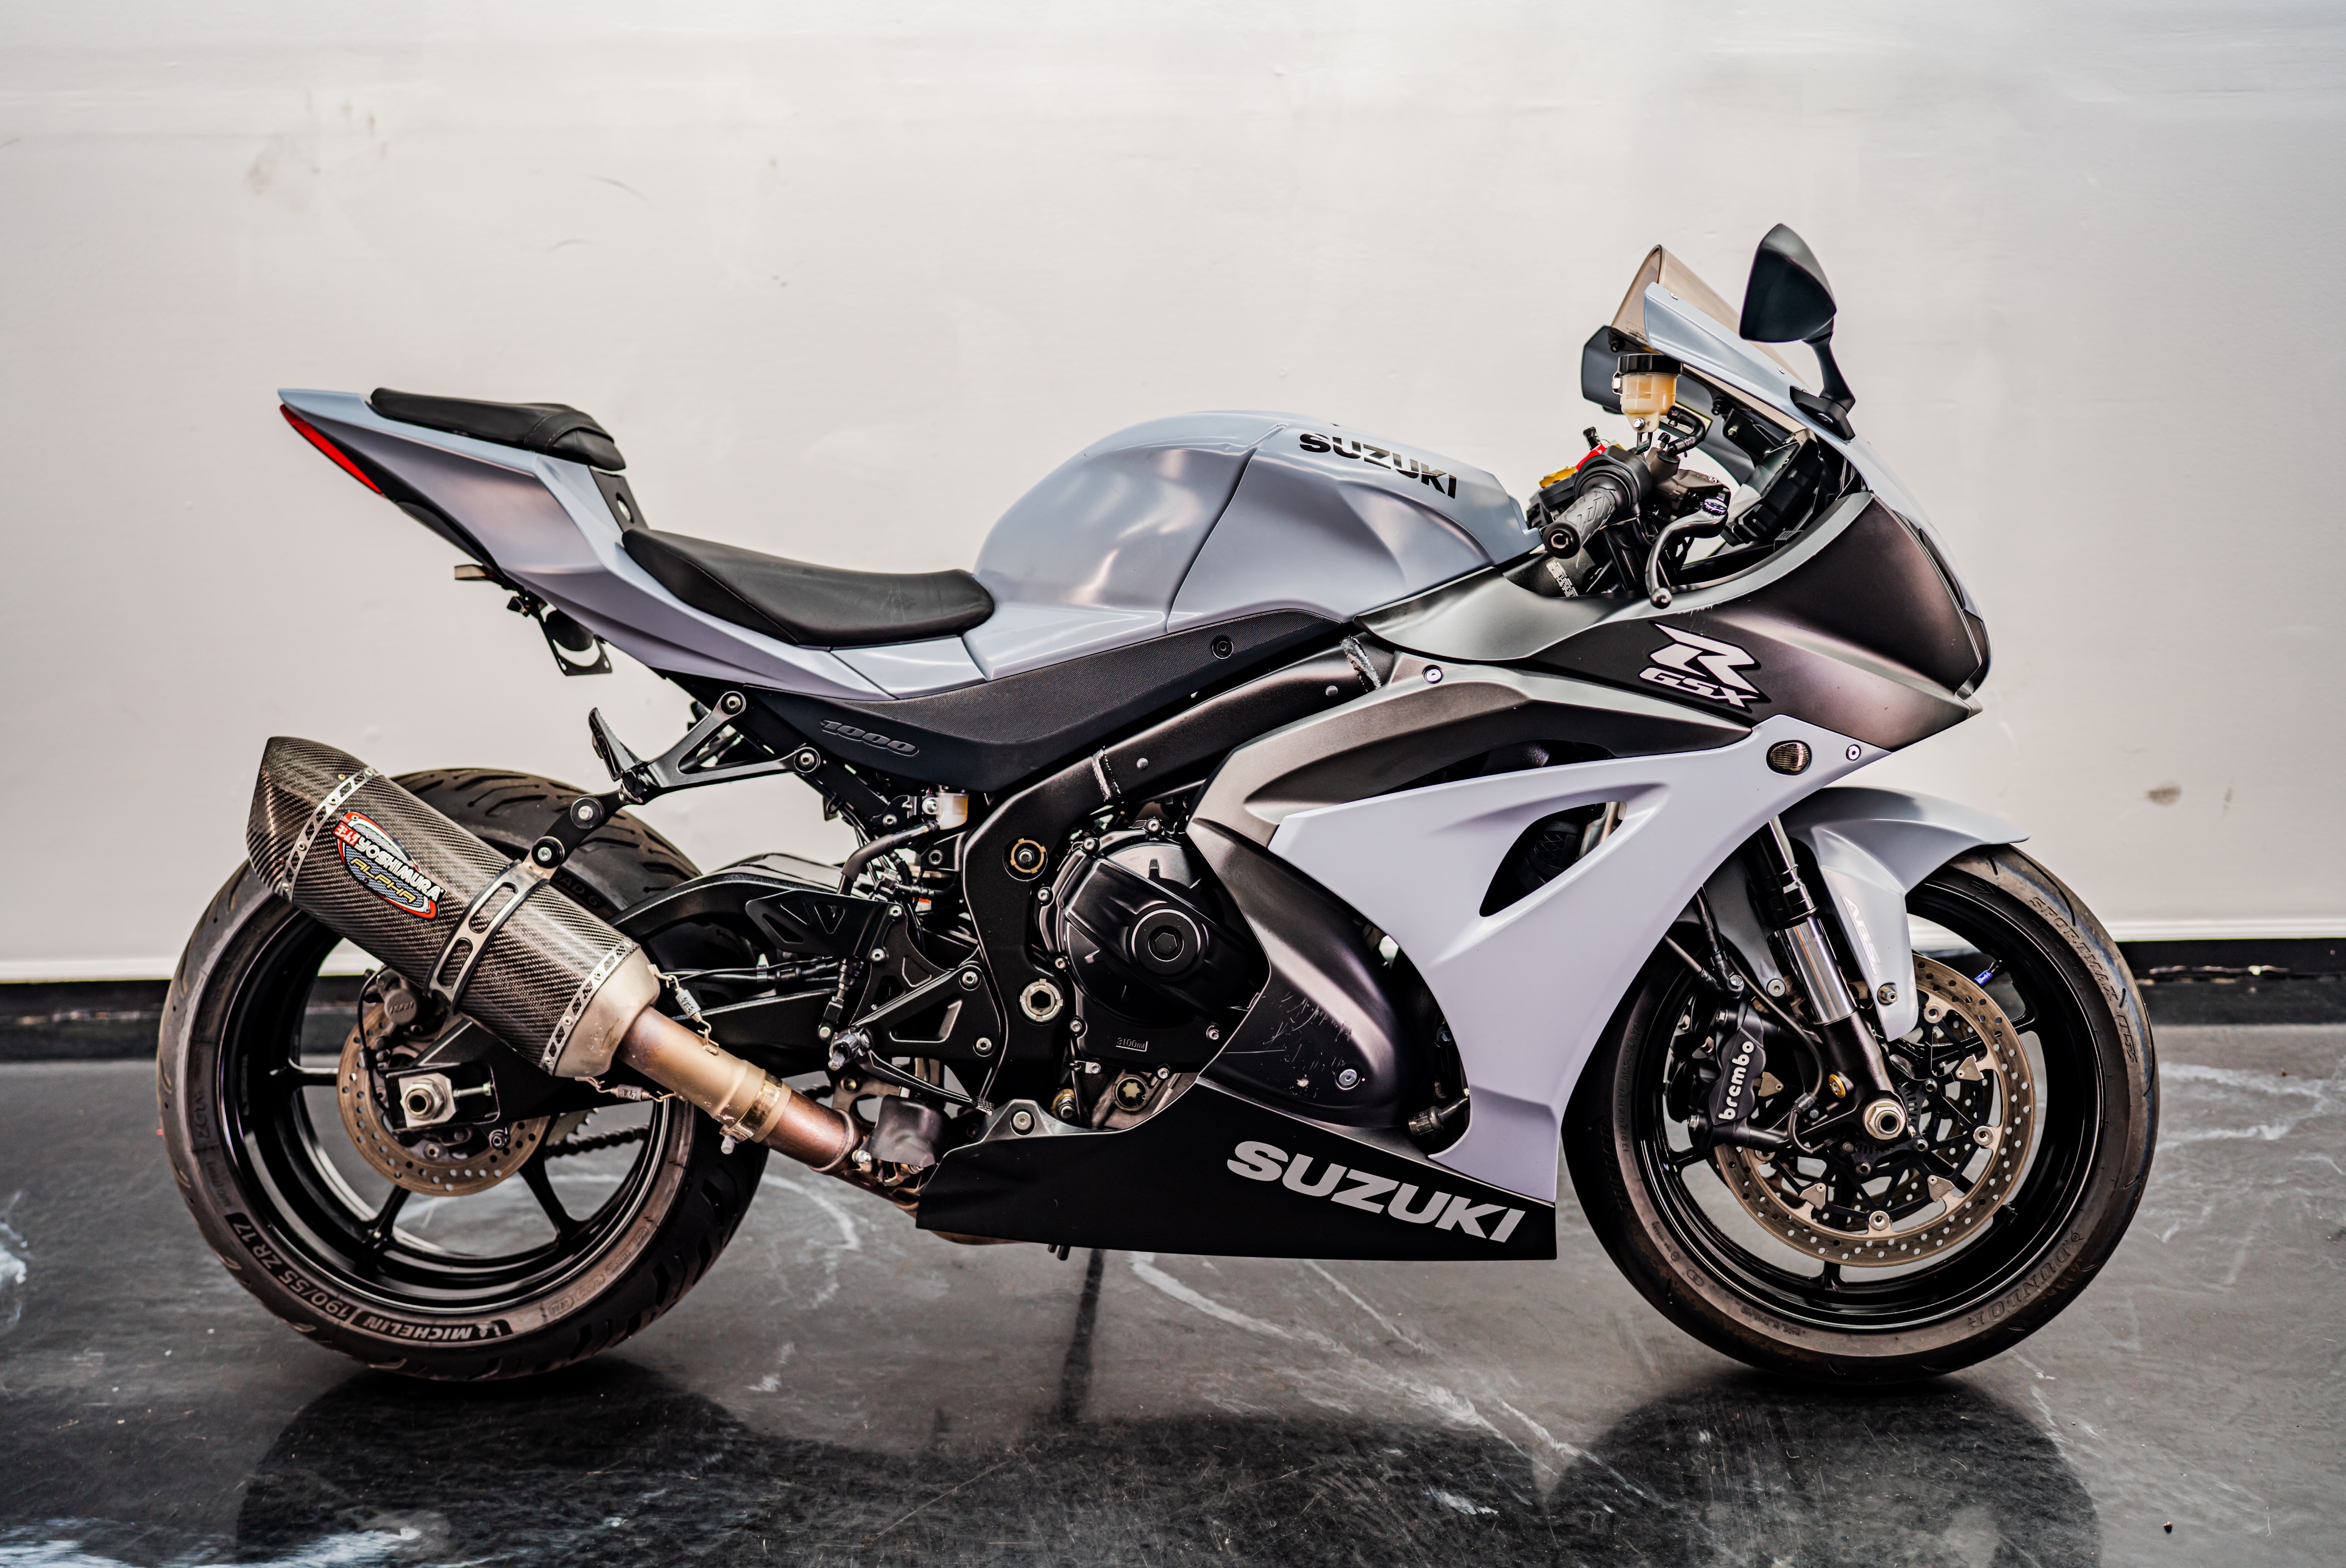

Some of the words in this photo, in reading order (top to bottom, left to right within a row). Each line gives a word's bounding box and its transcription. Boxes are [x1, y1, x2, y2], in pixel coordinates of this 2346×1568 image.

[1299, 433, 1457, 499] SUZUKI
[1639, 667, 1758, 708] GSX
[821, 720, 919, 757] 1000
[350, 858, 416, 903] ALPHA
[355, 836, 441, 902] YOSHIMURA
[588, 895, 601, 905] 6
[1844, 895, 1880, 965] ABS
[2028, 896, 2119, 1001] SPORTMAX
[1117, 1037, 1145, 1049] 3100ml
[1718, 1041, 1754, 1120] brembo
[1227, 1141, 1526, 1243] SUZUKI
[233, 1223, 257, 1242] 17
[252, 1243, 282, 1269] ZR
[279, 1270, 350, 1317] 190/55
[363, 1316, 473, 1340] MICHELIN
